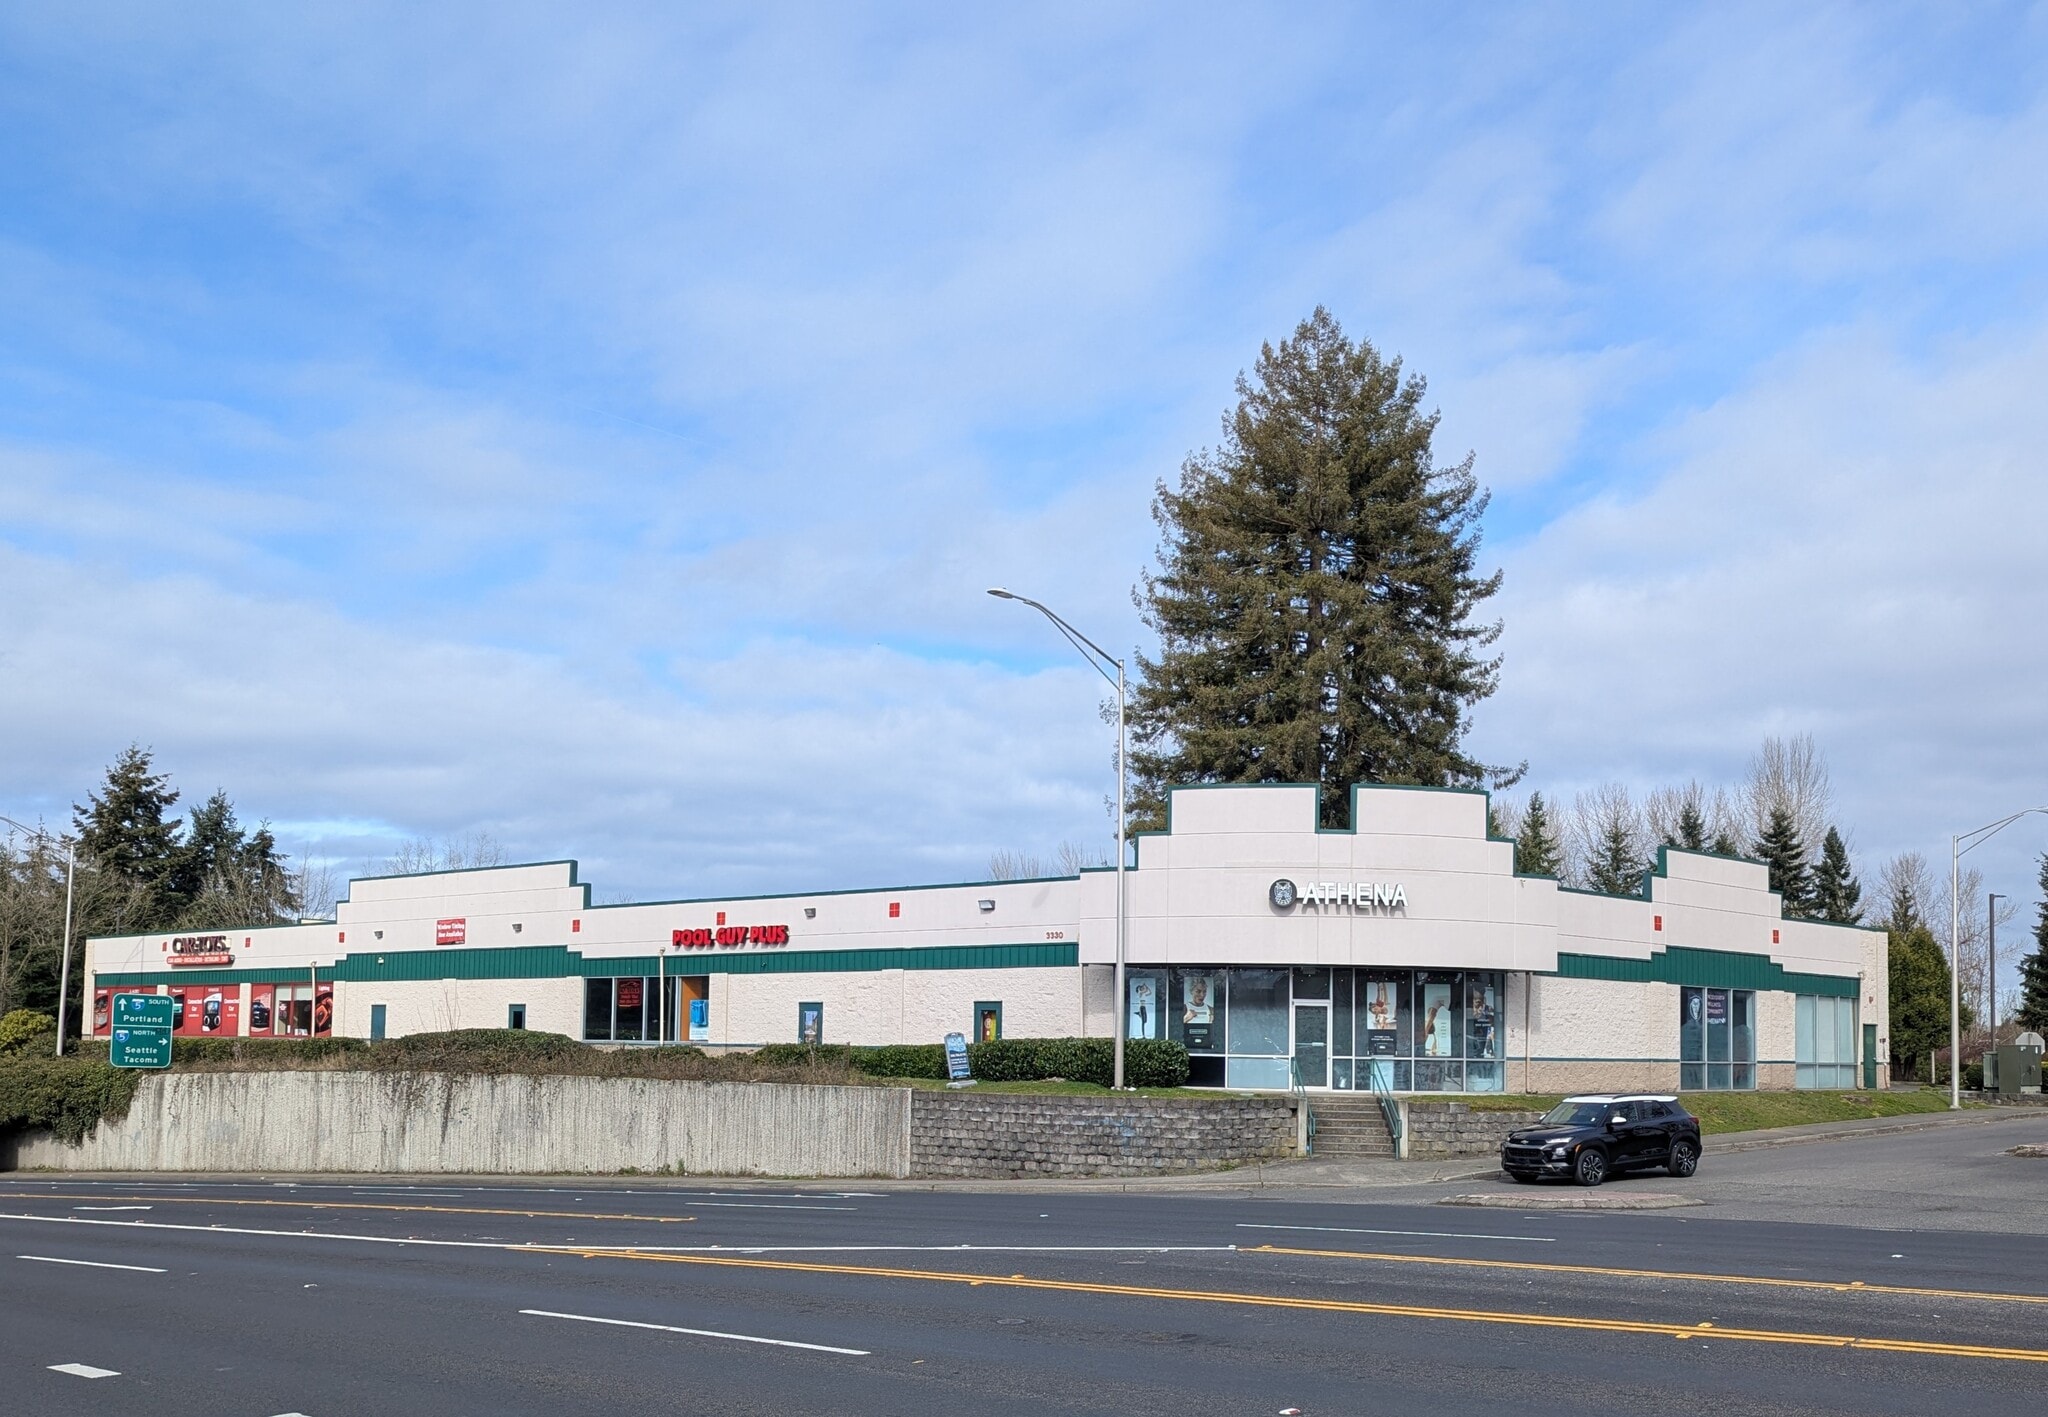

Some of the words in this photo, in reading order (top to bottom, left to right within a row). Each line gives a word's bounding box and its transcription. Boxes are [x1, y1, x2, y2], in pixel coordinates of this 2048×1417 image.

[1302, 882, 1409, 907] ATHENA
[672, 929, 713, 947] POOL
[716, 927, 748, 945] GUY
[750, 925, 788, 944] PLUS
[1046, 931, 1064, 940] 3330
[123, 1014, 163, 1023] Portland
[125, 1046, 158, 1054] Seattle
[123, 1056, 158, 1064] Tacoma
